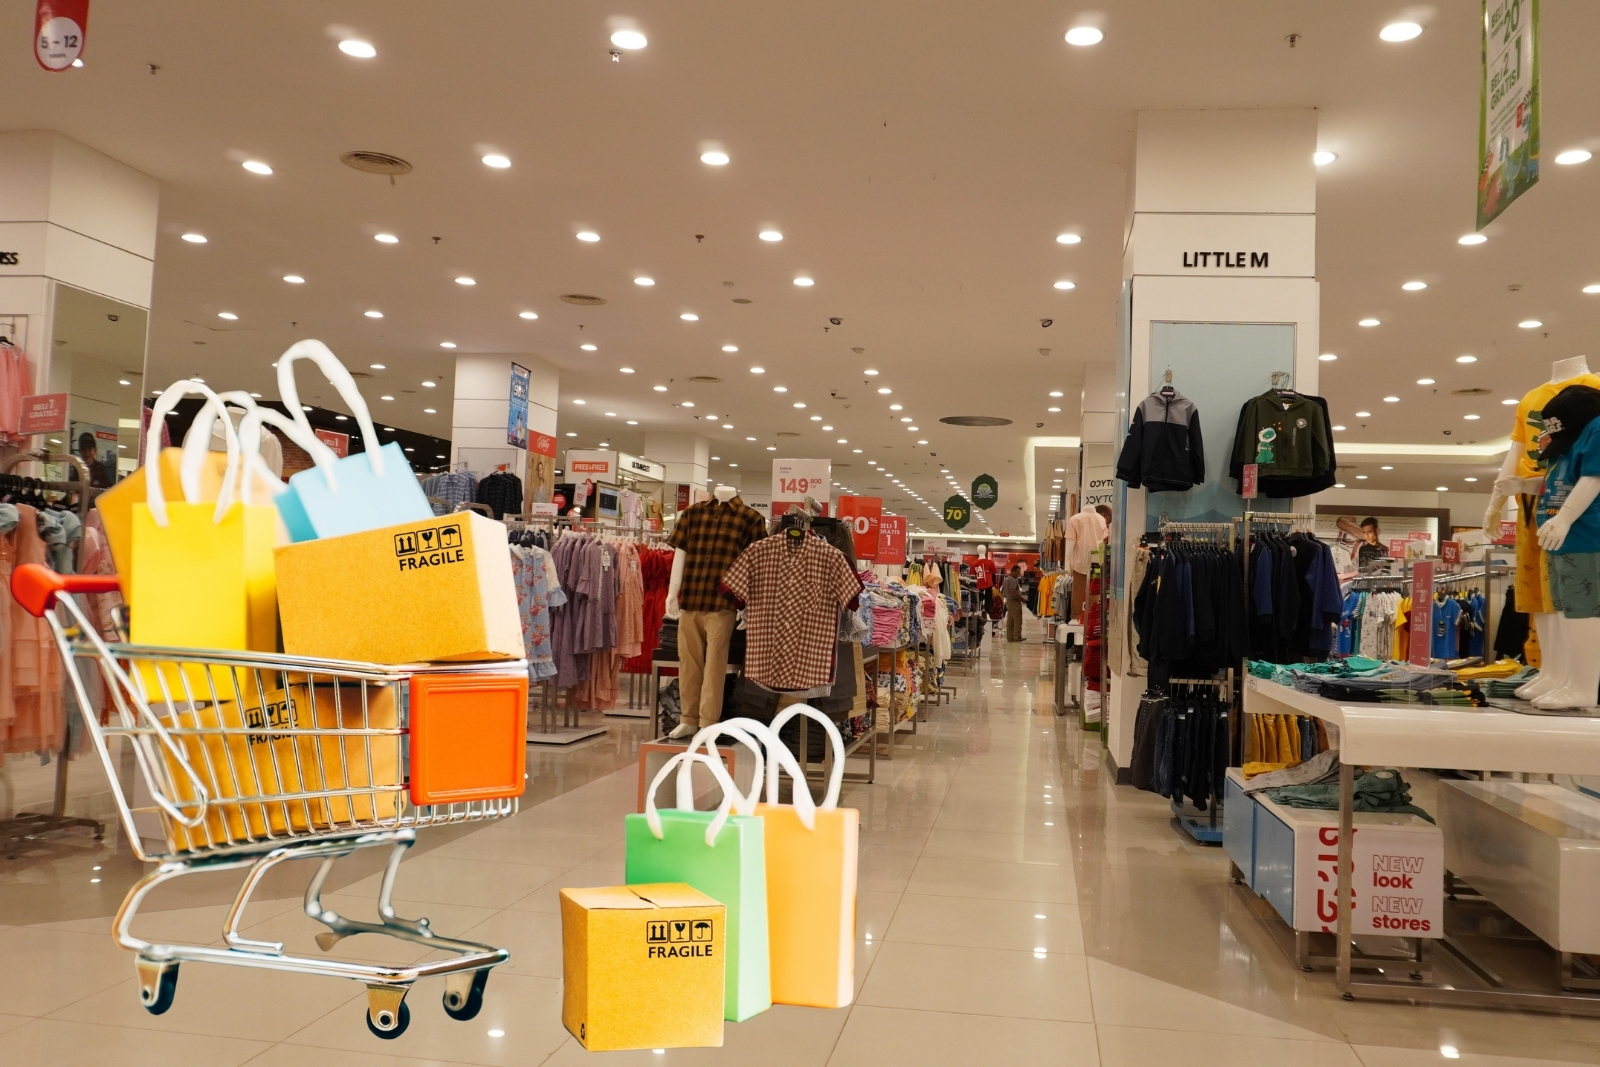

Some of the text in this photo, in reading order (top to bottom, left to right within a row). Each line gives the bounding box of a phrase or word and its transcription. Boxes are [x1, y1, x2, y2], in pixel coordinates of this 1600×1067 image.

[63, 35, 78, 48] 12
[1491, 51, 1509, 93] BELI 2
[1491, 69, 1516, 111] GRATIS
[1183, 251, 1270, 269] LITTLE M
[779, 478, 809, 494] 149
[399, 549, 465, 571] FRAGILE
[249, 724, 299, 746] FRGIL
[1372, 854, 1425, 874] NEW
[1373, 872, 1414, 889] look
[1371, 895, 1424, 914] NEW
[1371, 914, 1432, 932] stores
[648, 944, 713, 959] FRAGILE
